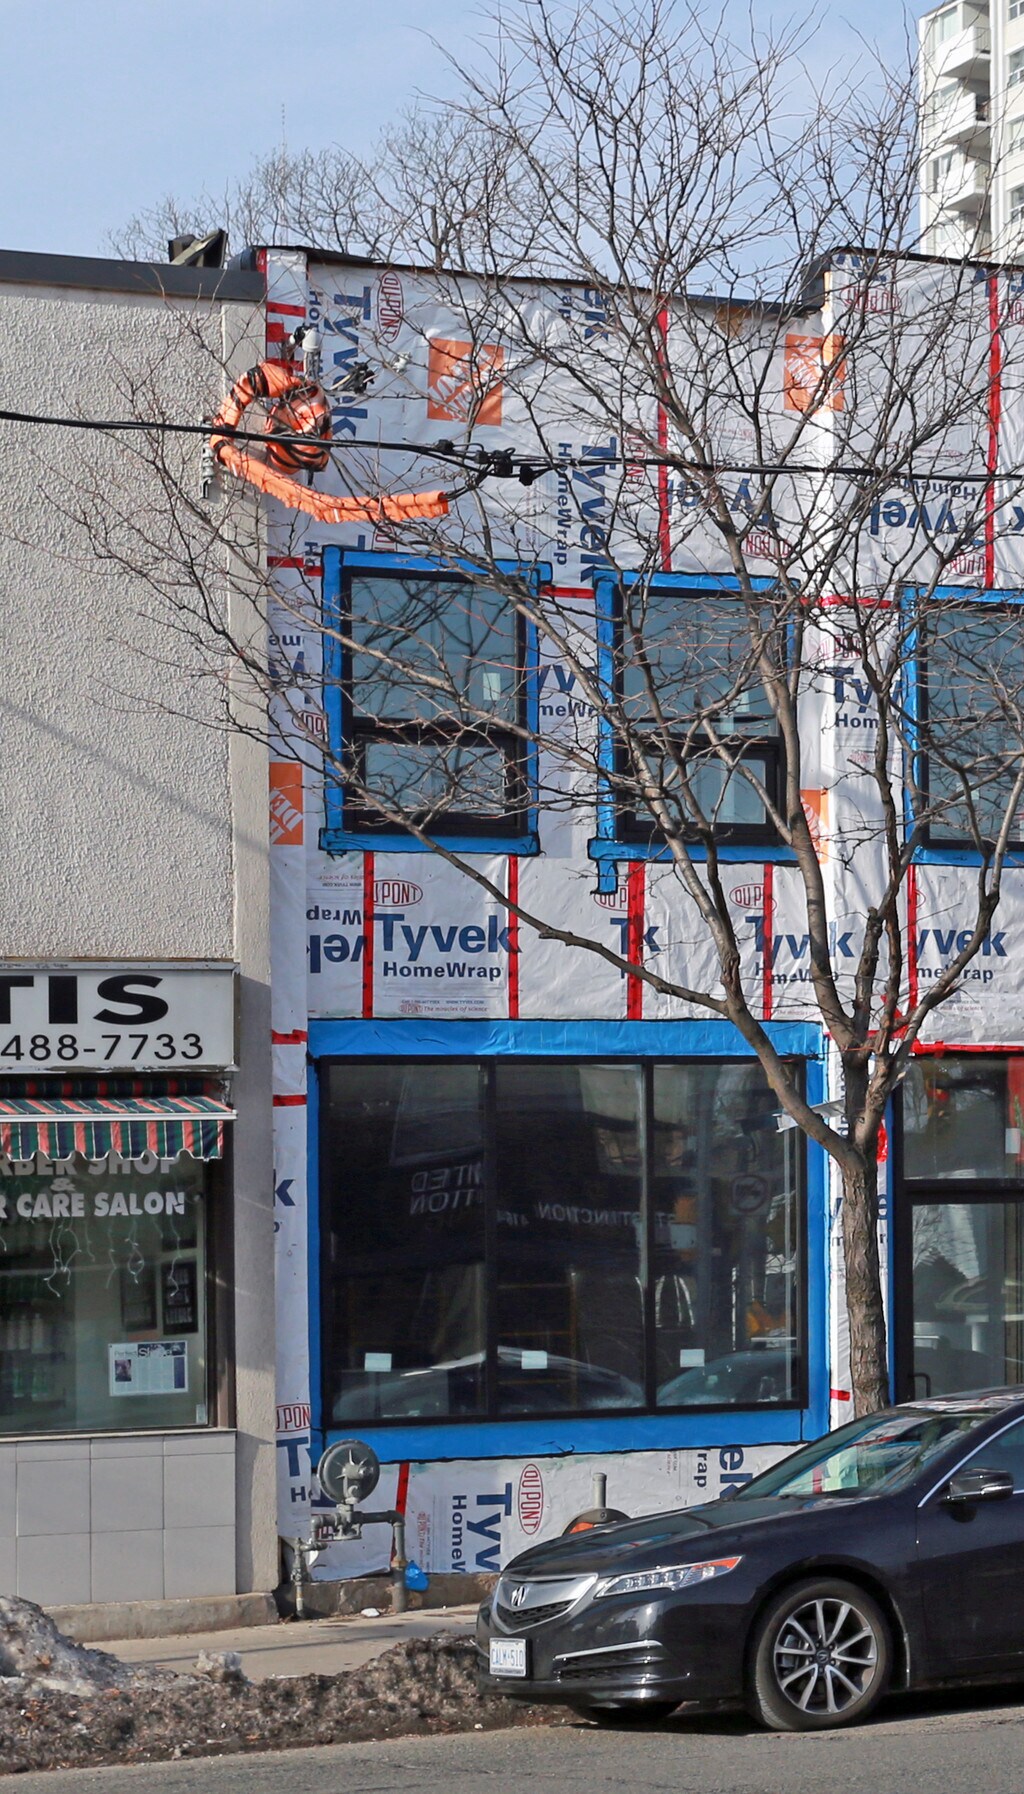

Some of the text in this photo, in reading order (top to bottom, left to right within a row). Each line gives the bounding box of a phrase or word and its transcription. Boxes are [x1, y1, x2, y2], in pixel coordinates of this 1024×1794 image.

[572, 436, 616, 582] Tyvek
[373, 913, 523, 962] Tyvek
[383, 961, 502, 981] HomeWrap
[0, 1033, 203, 1061] 488-7733
[50, 1177, 76, 1192] &
[16, 1193, 85, 1218] CARE
[94, 1191, 185, 1218] SALON
